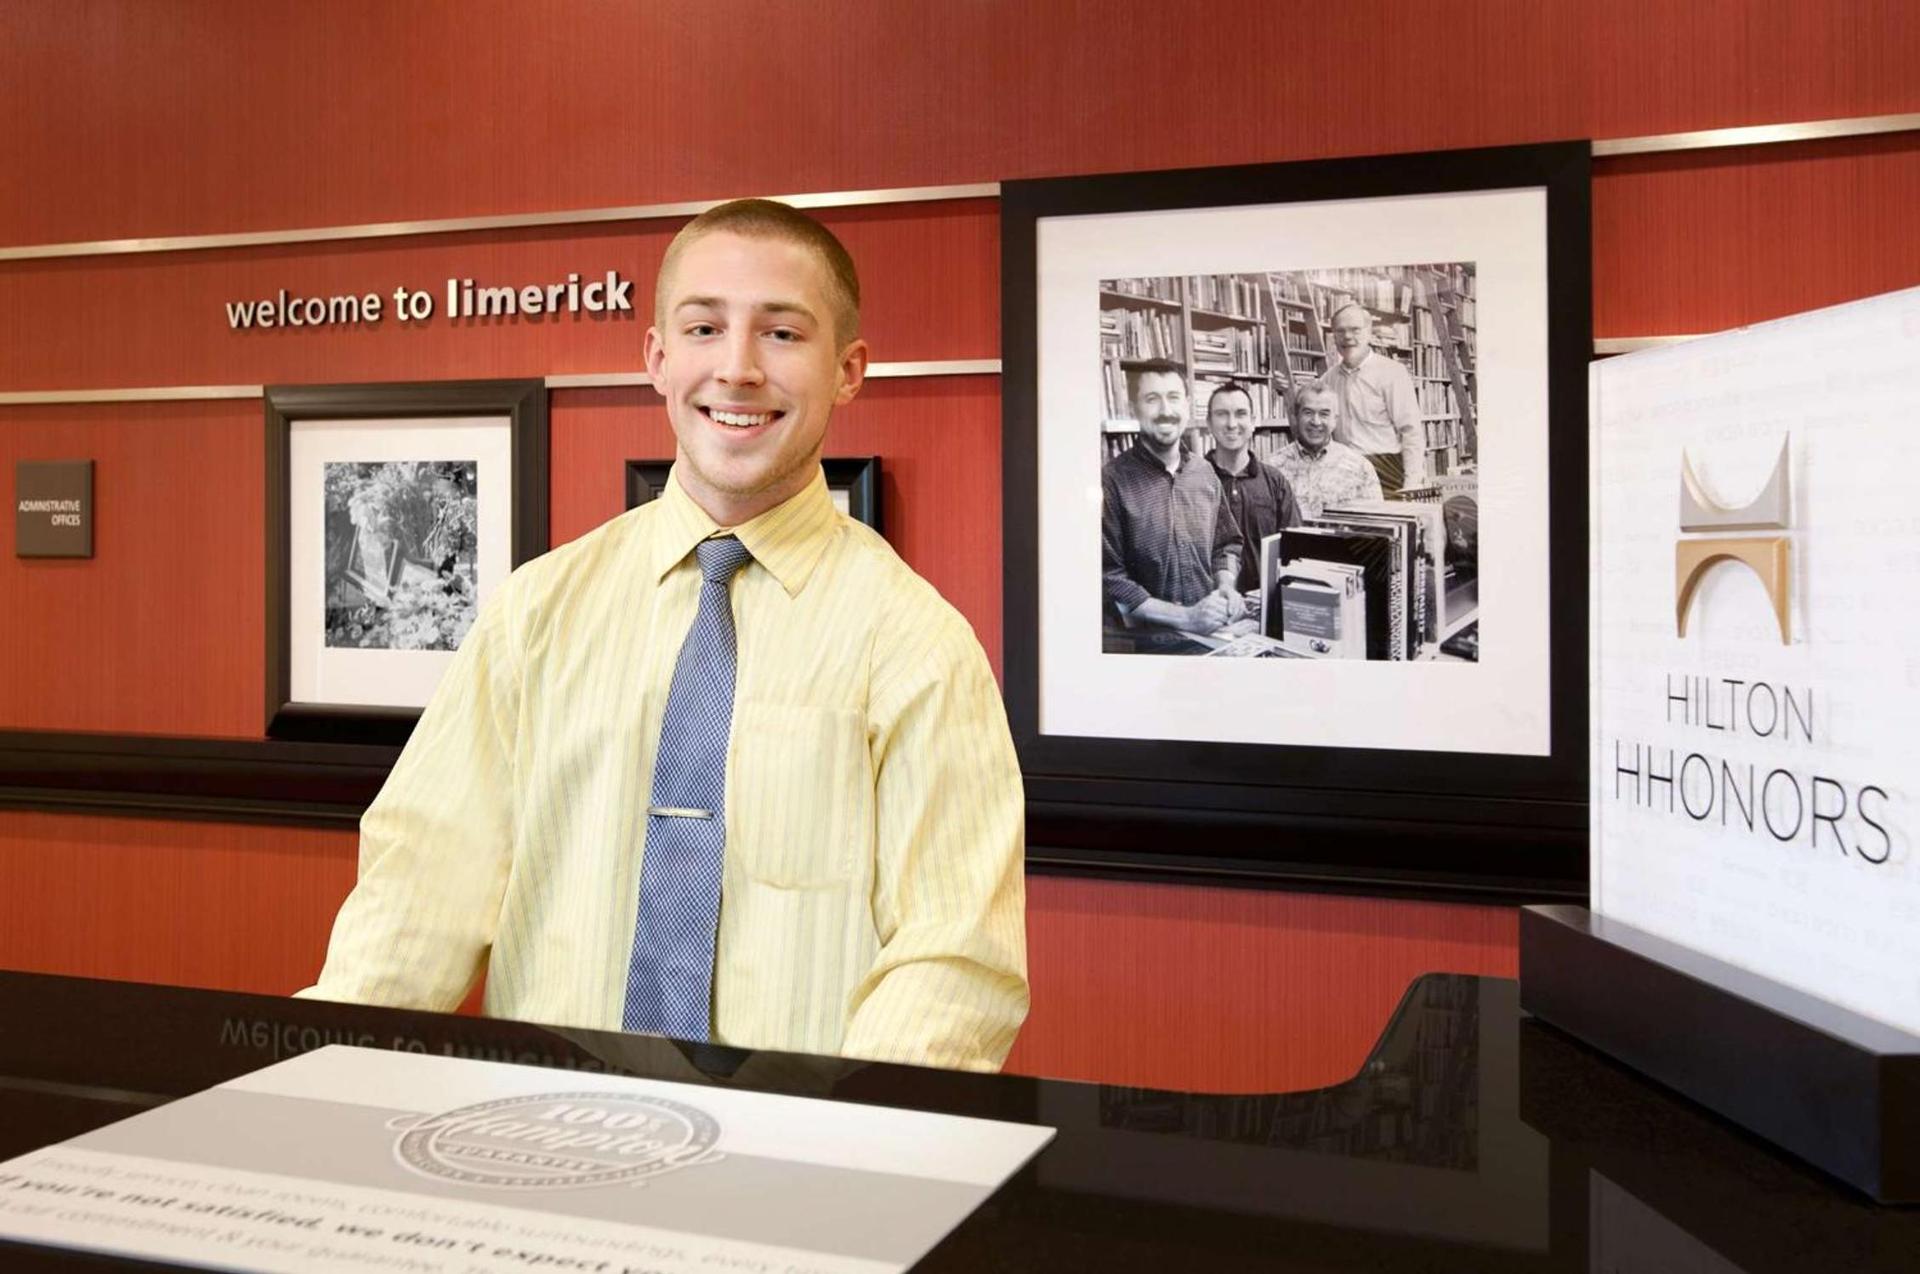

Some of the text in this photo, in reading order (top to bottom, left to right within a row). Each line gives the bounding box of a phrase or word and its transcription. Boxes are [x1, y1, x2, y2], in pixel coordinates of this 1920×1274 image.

[225, 271, 632, 328] welcome to limerick
[18, 500, 81, 512] ADMINISTRATIVE
[51, 514, 81, 526] OFFICES
[1667, 673, 1813, 744] HILTON
[1615, 739, 1891, 865] HHONORS
[13, 1180, 115, 1199] you're
[119, 1193, 180, 1208] not
[335, 1223, 385, 1239] we
[392, 1231, 486, 1254] don't
[491, 1247, 611, 1273] expect
